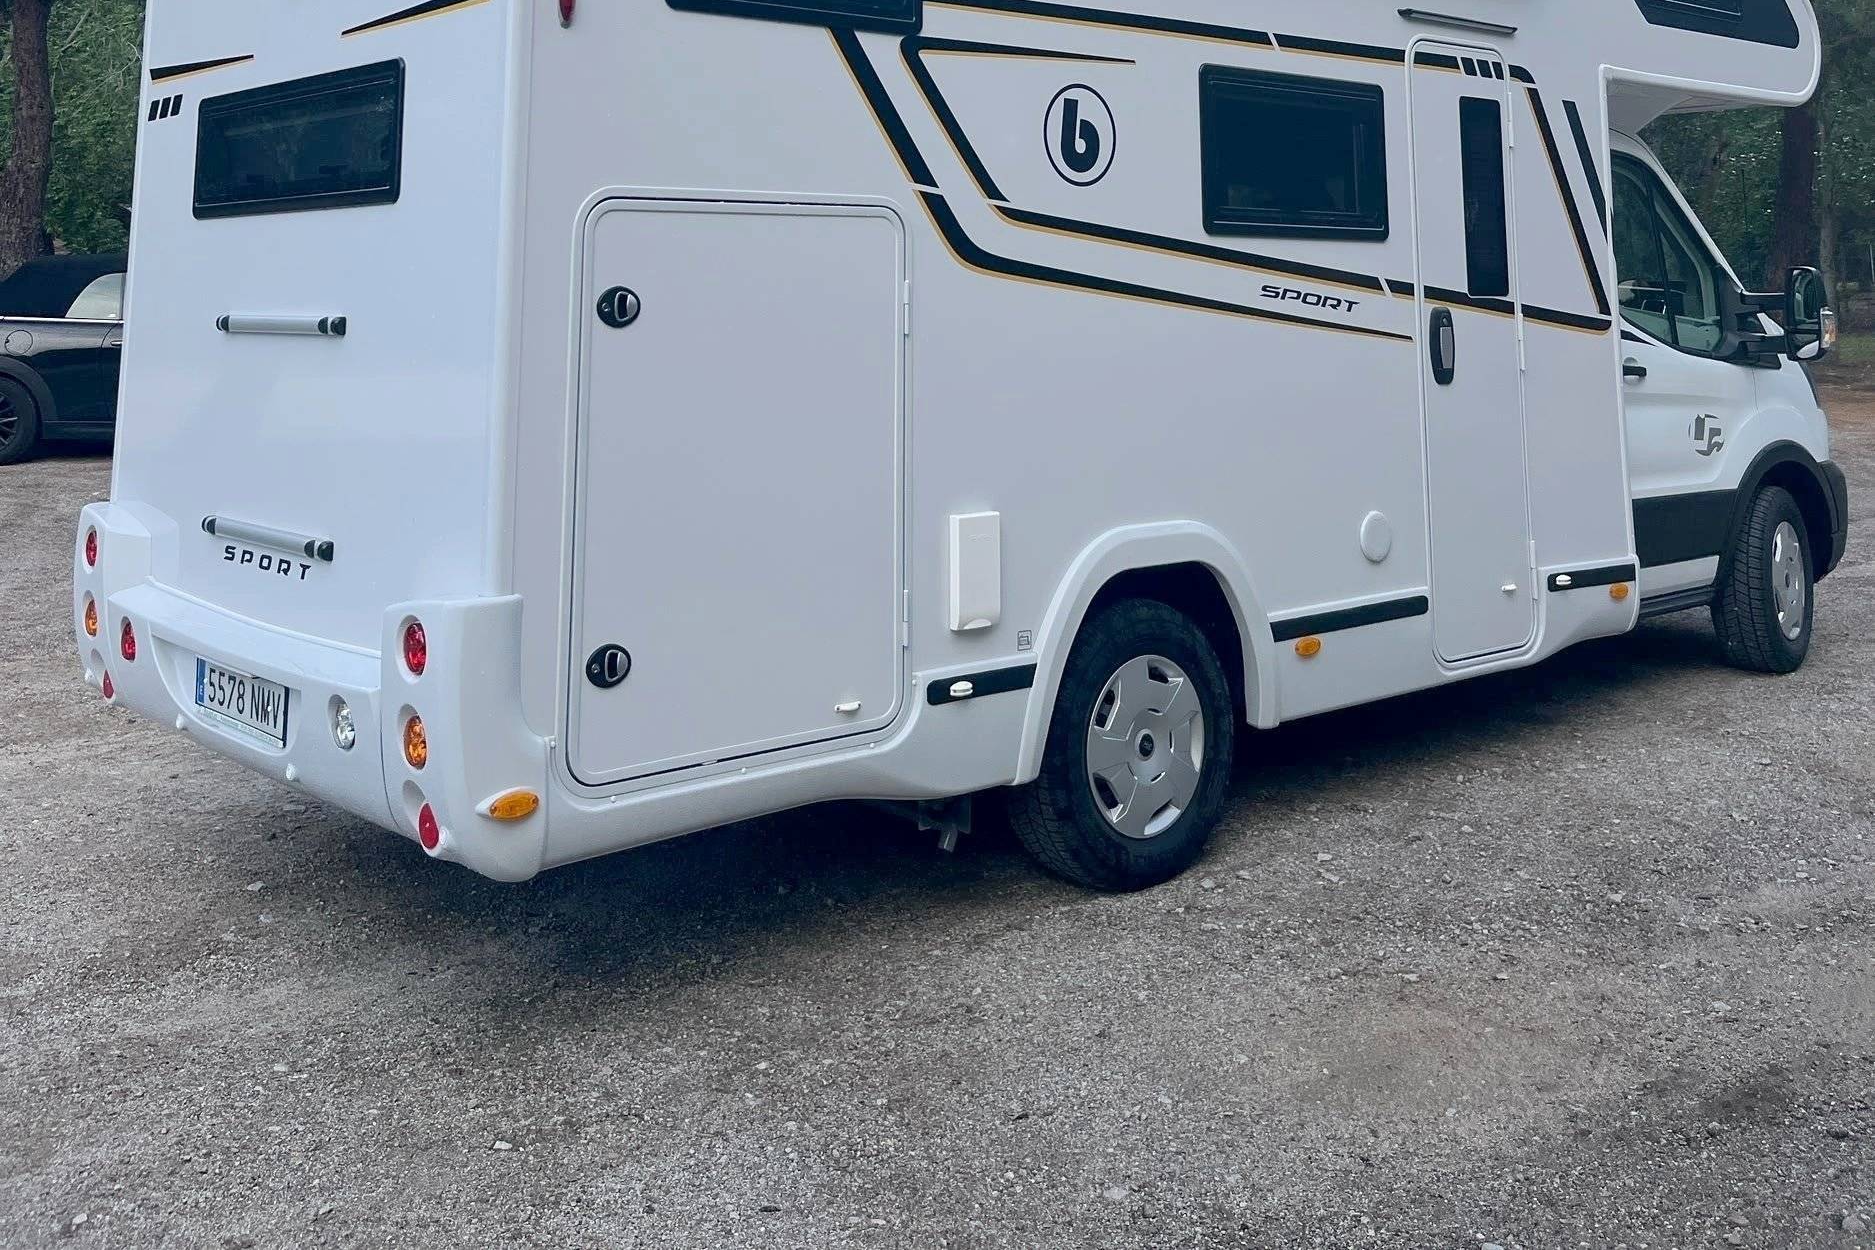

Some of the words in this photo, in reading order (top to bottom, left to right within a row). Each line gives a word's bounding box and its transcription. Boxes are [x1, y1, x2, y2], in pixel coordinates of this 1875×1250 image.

[1259, 285, 1360, 312] SPORT
[223, 545, 312, 580] SPORT
[208, 667, 246, 715] 5578
[250, 683, 282, 729] NMV
